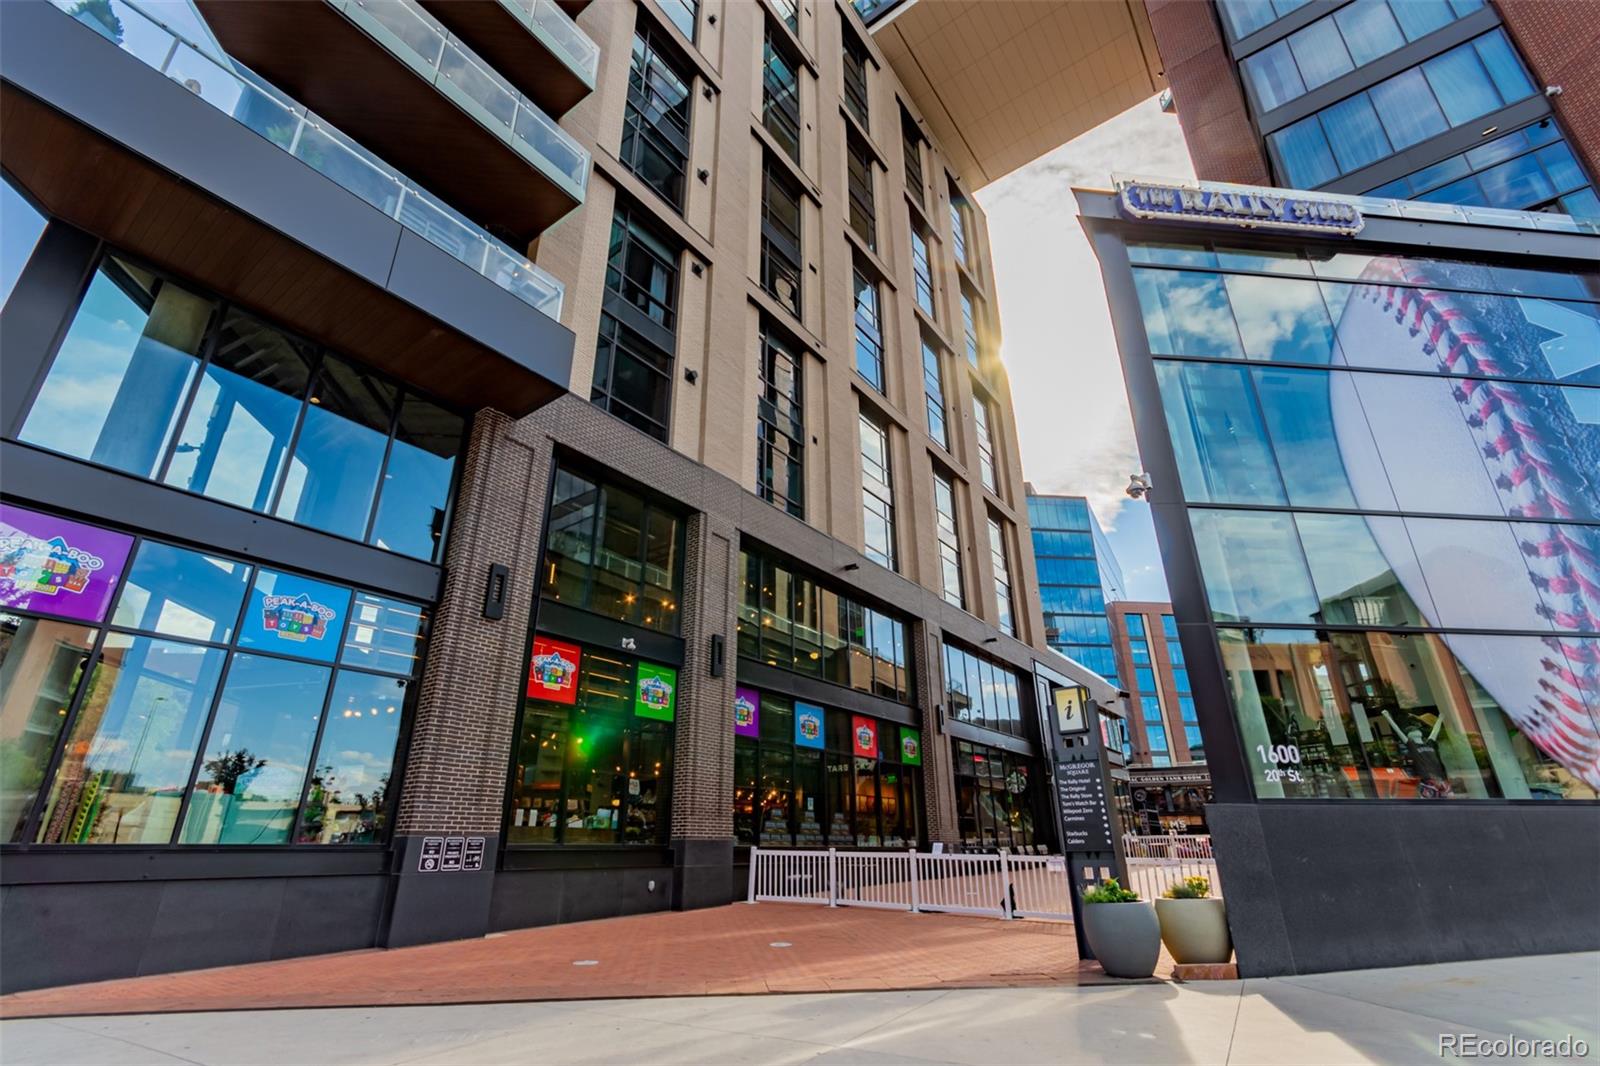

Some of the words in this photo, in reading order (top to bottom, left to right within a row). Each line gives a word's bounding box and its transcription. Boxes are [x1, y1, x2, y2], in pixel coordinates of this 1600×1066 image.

[1136, 186, 1176, 207] THE
[1179, 189, 1287, 218] RALLY
[264, 595, 335, 619] PEAK-A-BOO
[267, 618, 312, 634] TOYS
[1256, 744, 1301, 764] 1600
[1264, 768, 1286, 782] 20th
[1287, 768, 1305, 783] St.
